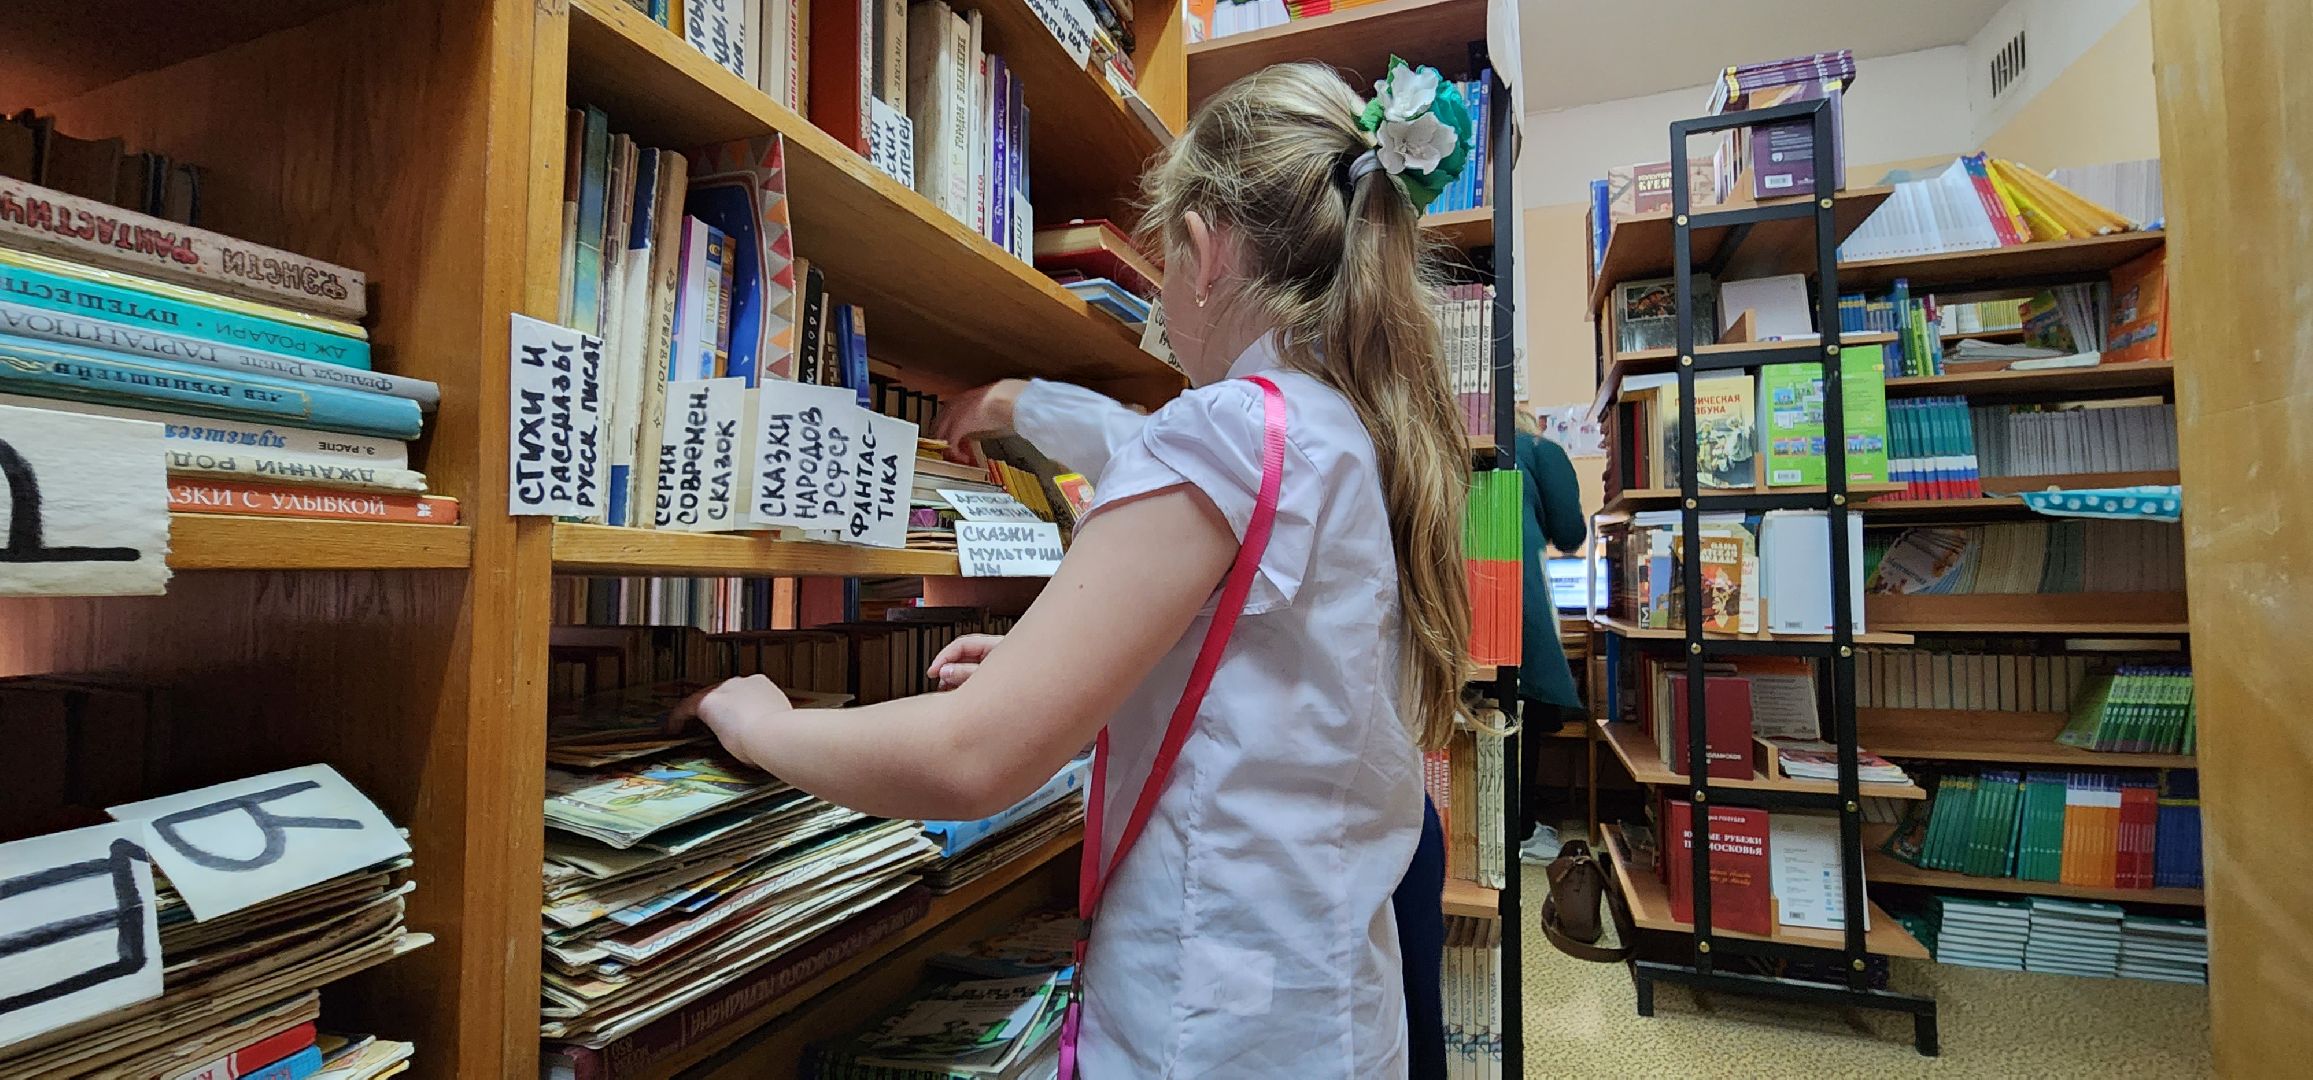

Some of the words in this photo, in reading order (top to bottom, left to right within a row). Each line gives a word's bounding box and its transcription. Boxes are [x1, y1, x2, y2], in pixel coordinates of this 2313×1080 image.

[872, 120, 881, 170] ЗКИ
[0, 195, 199, 265] ФАНТАСТИЧ
[215, 320, 306, 353] РОДАРИ
[521, 344, 548, 369] И
[54, 361, 231, 399] РУБИНШТЕЙН
[243, 387, 283, 404] ЛЕВ
[1694, 404, 1727, 416] ЗБУКА
[166, 452, 236, 474] РОД
[318, 440, 360, 455] РАСПЕ
[518, 387, 548, 506] СТИХИ
[676, 386, 710, 525] СОВРЕМЕН.
[760, 413, 794, 517] СКАЗКИ
[793, 405, 823, 520] НАРОДОВ
[255, 456, 376, 484] ДЖАННИ
[708, 418, 737, 520] СКАЗОК
[822, 427, 850, 517] РСФСР
[878, 454, 899, 522] ТИКА
[243, 487, 262, 509] С
[271, 489, 387, 517] УЛЫБКОЙ
[1724, 833, 1763, 846] РУБЕЖИ
